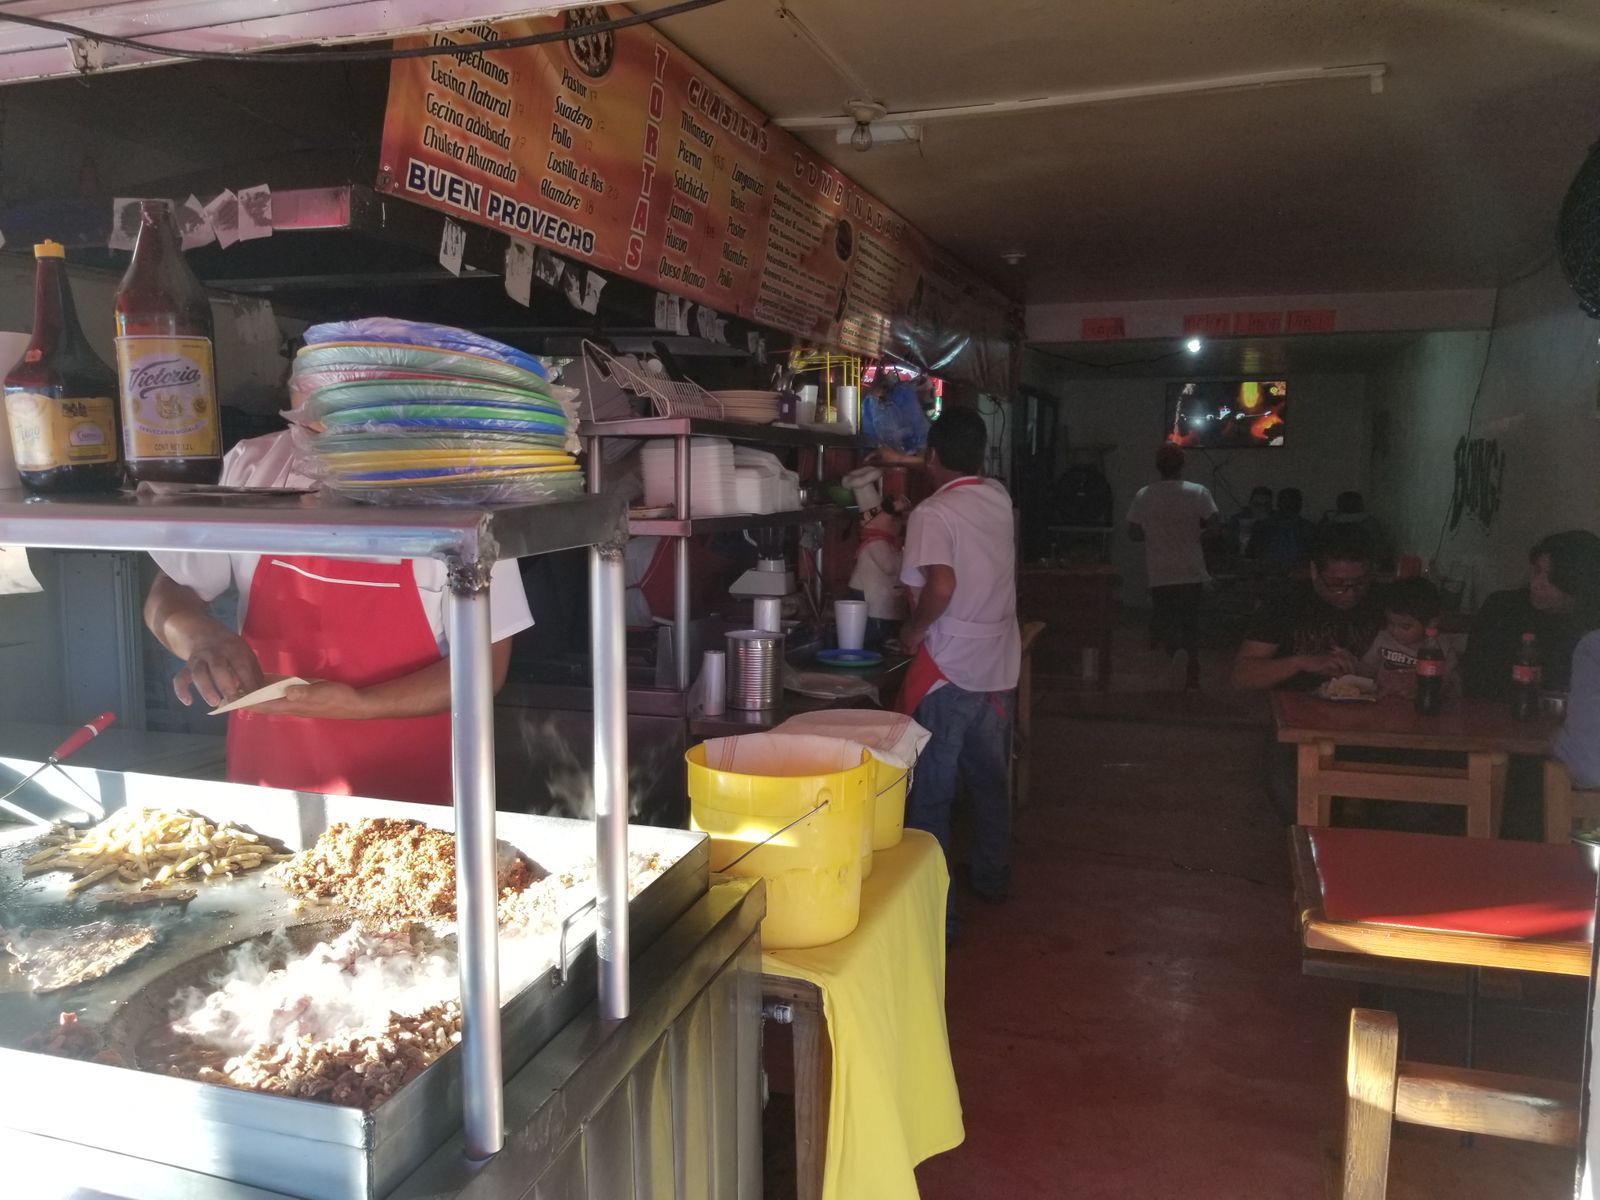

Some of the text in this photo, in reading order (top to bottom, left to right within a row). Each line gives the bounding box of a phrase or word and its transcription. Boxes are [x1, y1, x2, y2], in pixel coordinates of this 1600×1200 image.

[431, 60, 512, 118] Cecina Natural
[562, 68, 587, 98] Pastor
[427, 93, 511, 150] Cecina adobada
[555, 96, 593, 130] Suadero
[687, 76, 768, 153] CLASICAS
[551, 123, 572, 149] Pollo
[423, 126, 517, 183] Chuleta Ahumada
[625, 43, 669, 270] TORTAS
[678, 140, 702, 170] Pierna
[547, 152, 578, 181] Costilla
[578, 167, 591, 187] de
[591, 171, 604, 193] Res
[674, 170, 709, 204] Salchicha
[408, 159, 482, 215] BUEN
[486, 191, 597, 256] PROVECHO
[540, 178, 581, 211] Alambre
[793, 151, 904, 242] COMBINADAS
[667, 199, 694, 227] Jamón
[727, 216, 747, 240] Pastor
[665, 227, 688, 253] Huevo
[659, 256, 706, 288] Queso Blanco
[129, 359, 201, 397] Victoria
